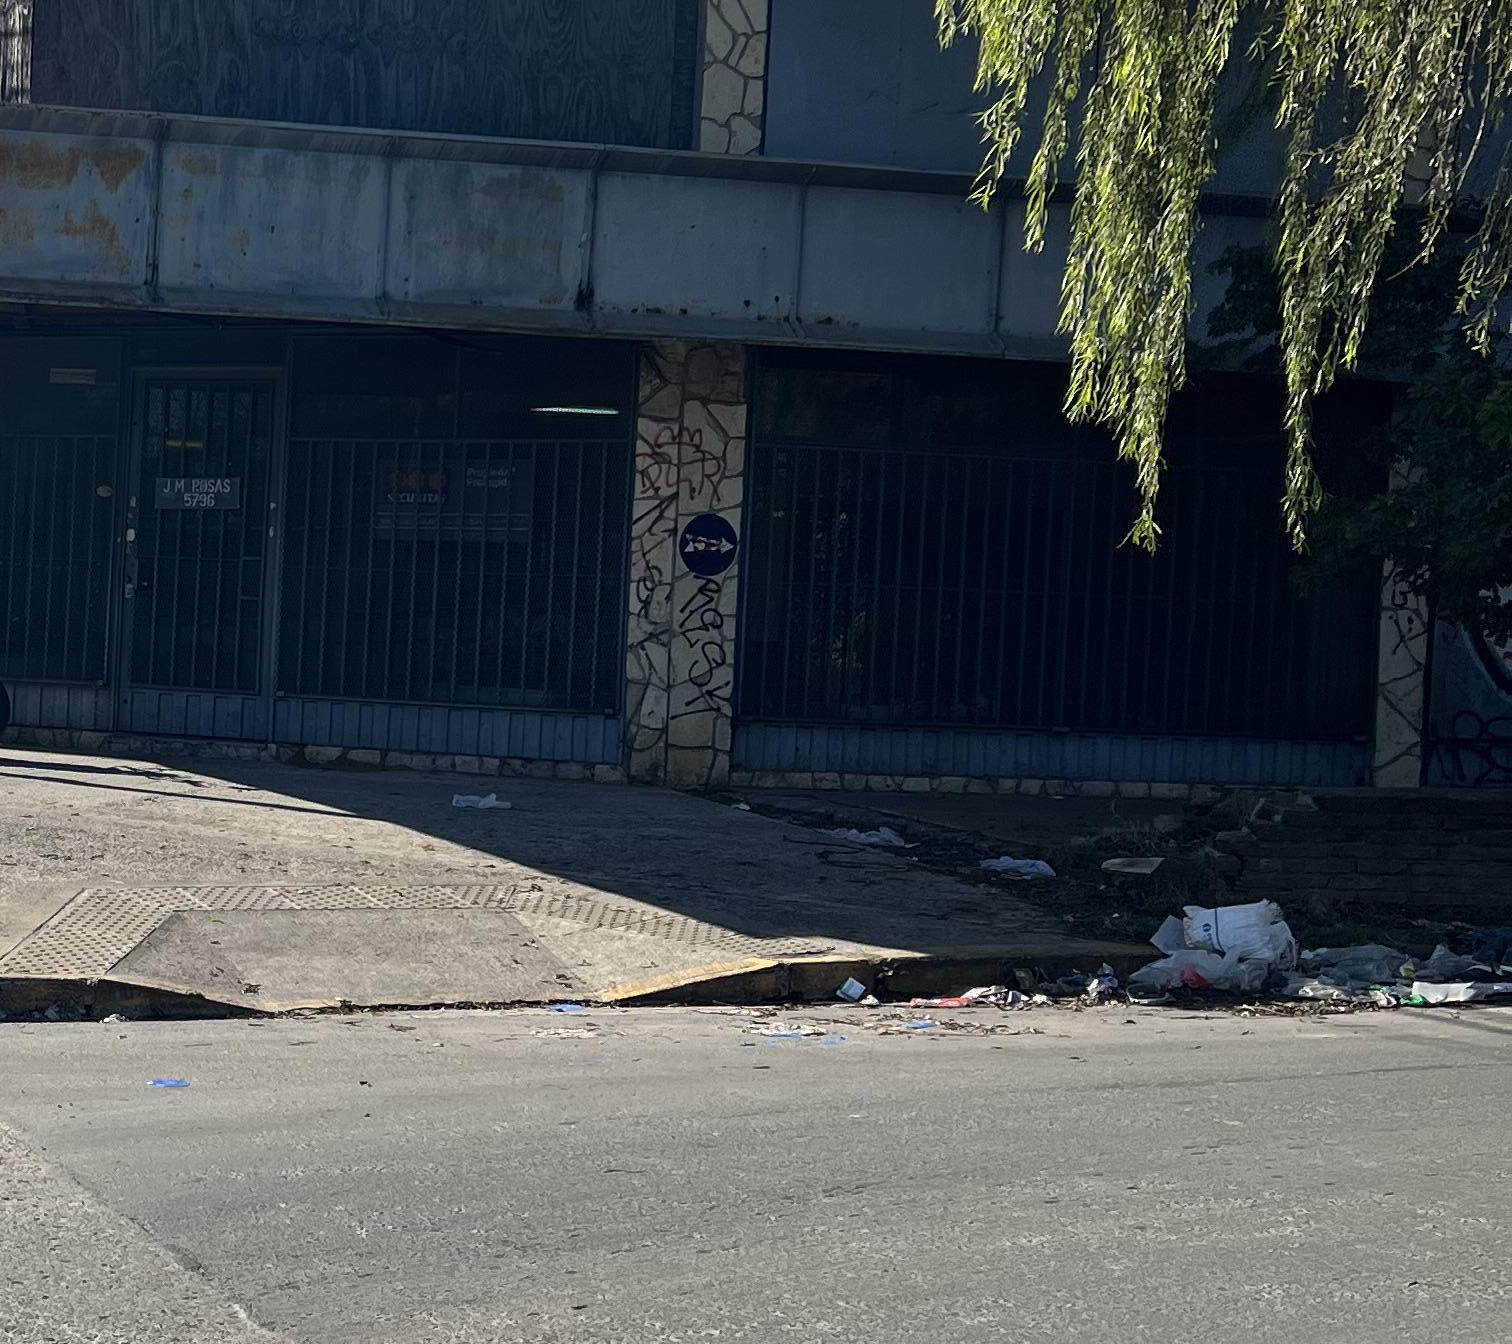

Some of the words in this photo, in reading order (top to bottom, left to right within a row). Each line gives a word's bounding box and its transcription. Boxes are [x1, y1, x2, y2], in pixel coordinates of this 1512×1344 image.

[163, 479, 171, 493] J
[175, 479, 185, 493] M
[191, 478, 231, 493] ROSAS
[184, 493, 215, 507] 5796
